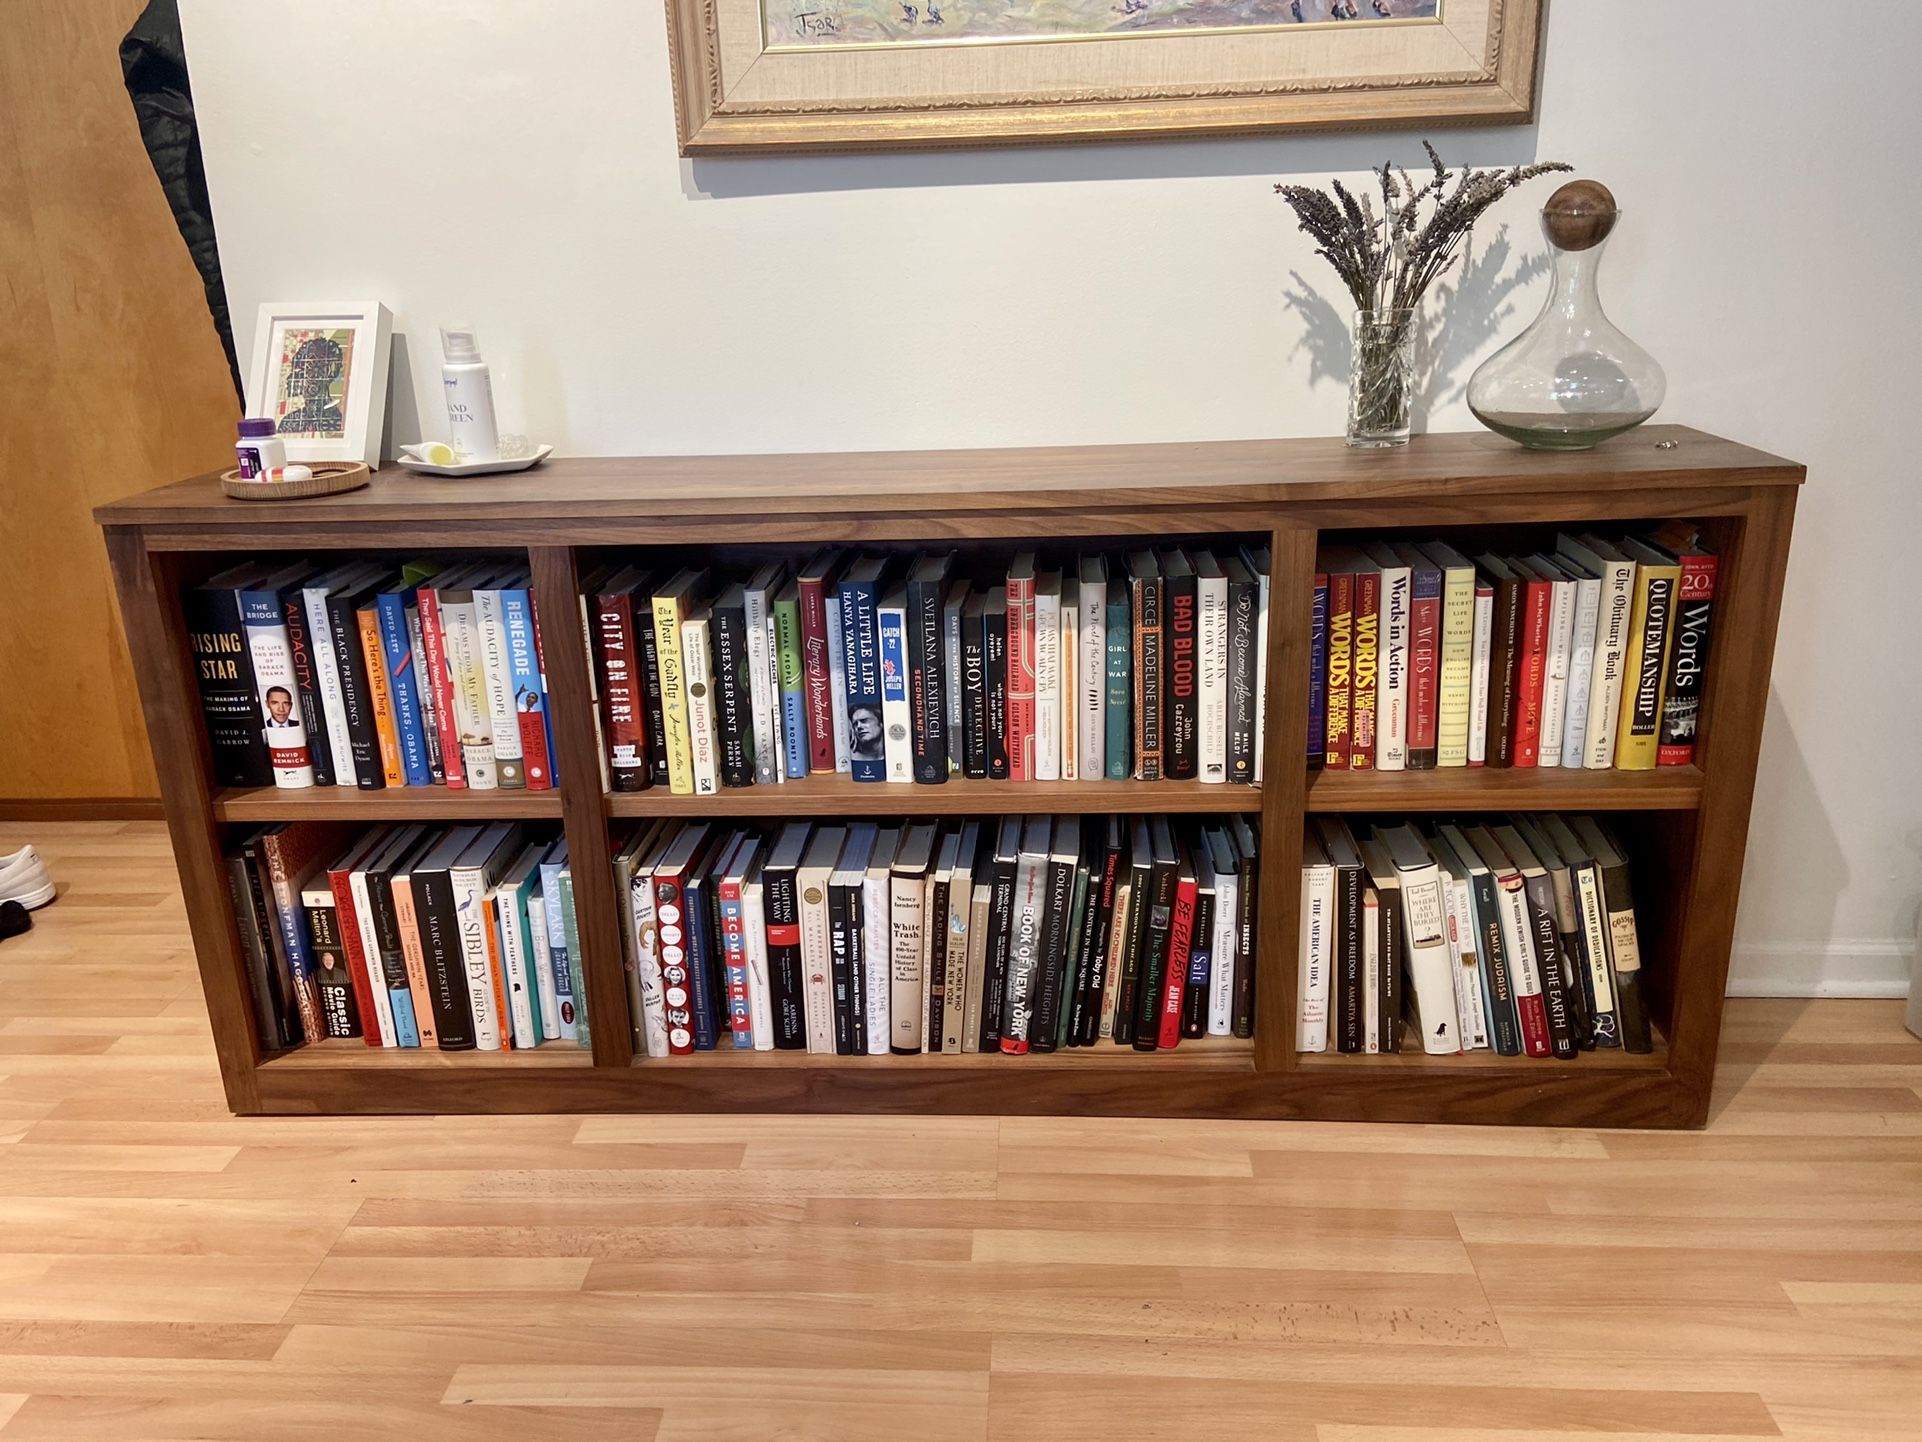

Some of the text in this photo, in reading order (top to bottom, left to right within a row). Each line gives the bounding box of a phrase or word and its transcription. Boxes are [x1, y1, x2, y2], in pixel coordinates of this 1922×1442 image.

[332, 609, 341, 625] THE
[386, 606, 395, 631] DAVID
[481, 595, 492, 611] The
[1144, 585, 1156, 625] CIRCE
[1680, 590, 1712, 598] Century
[190, 632, 242, 653] RISING
[286, 603, 312, 690] AUDACITY
[336, 627, 348, 661] BLACK
[484, 613, 499, 669] AUDACITY
[507, 601, 529, 676] RENEGADE
[843, 592, 857, 695] HANYA YANAGIHARA
[857, 591, 875, 695] A LITTLE LIFE
[883, 627, 900, 637] CATCH
[1010, 584, 1019, 692] THE UNDERGROUND RAILROAD
[1173, 594, 1193, 697] BAD BLOOD
[1237, 612, 1250, 633] Not
[1389, 577, 1407, 689] Words in Action
[1674, 602, 1711, 688] Words
[200, 660, 238, 680] STAR
[313, 604, 336, 700] HERE ALL ALONG
[422, 598, 448, 731] They Said This Day Would Never Come
[601, 613, 631, 722] CITY ON FIRE
[721, 632, 731, 672] ESSEX
[924, 598, 939, 739] SVETLANA ALEXIEVICH
[966, 645, 981, 654] The
[989, 633, 997, 662] oyeyemi
[1329, 612, 1352, 688] WORDS
[1355, 614, 1377, 688] WORDS
[1639, 579, 1668, 717] QUOTEMANSHIP
[343, 665, 359, 727] PRESIDENCY
[491, 674, 501, 683] of
[493, 686, 506, 716] HOPE
[808, 636, 828, 739] Literary Wonderlands
[914, 669, 923, 731] SECONDHAND
[1145, 636, 1157, 748] MADELINE MILLER
[1365, 689, 1375, 711] THAT
[399, 683, 419, 769] THANKS, OBAMA
[723, 675, 737, 733] SERPENT
[787, 697, 797, 760] SALLY ROONEY
[966, 657, 983, 755] BOY DETECTIVE
[1184, 717, 1192, 739] John
[1338, 688, 1349, 734] THAT MAKE
[1391, 699, 1400, 737] Greenman
[522, 723, 533, 756] WOLFFE
[531, 720, 543, 757] RICHARD
[1173, 704, 1184, 754] Carreyrou
[726, 741, 734, 767] PERRY
[734, 740, 742, 768] SARAH
[771, 881, 781, 920] THE WAY
[780, 879, 791, 922] LIGHTING
[1103, 853, 1118, 908] Times Squared
[1348, 871, 1357, 929] DEVELOPMENT
[311, 910, 322, 943] Maltin's
[320, 909, 332, 944] Leonard
[506, 931, 514, 945] WITH
[893, 923, 920, 931] White
[1041, 868, 1066, 1025] DOLKART MORNINGSIDE HEIGHTS
[1085, 908, 1094, 936] CENTURY
[1171, 898, 1191, 983] BE FEARLESS
[1310, 898, 1321, 988] THE AMERICAN IDEA
[1586, 891, 1597, 925] DICTIONARY
[1592, 935, 1603, 971] DEDICATIONS
[428, 915, 452, 1010] MARC BLITZSTEIN
[463, 922, 487, 1023] SIBLEY BIRDS
[509, 947, 517, 975] FEATHERS
[727, 908, 744, 1025] BECOME AMERICA
[947, 969, 955, 986] NEW
[956, 967, 964, 992] WOMEN
[1011, 906, 1034, 1036] BOOK OF NEW YORK
[1079, 967, 1088, 991] SQUARE
[1143, 933, 1162, 1022] The Smaller Majority
[1192, 955, 1206, 980] Salt
[1348, 942, 1356, 979] FREEDOM
[1489, 922, 1507, 1001] REMIX JUDAISM
[1537, 908, 1566, 1029] A RIFT IN THE EARTH
[327, 986, 340, 1035] Movie Guide
[334, 986, 351, 1036] Classic
[954, 995, 962, 1011] WHO
[1166, 985, 1180, 1014] JEAN CASE
